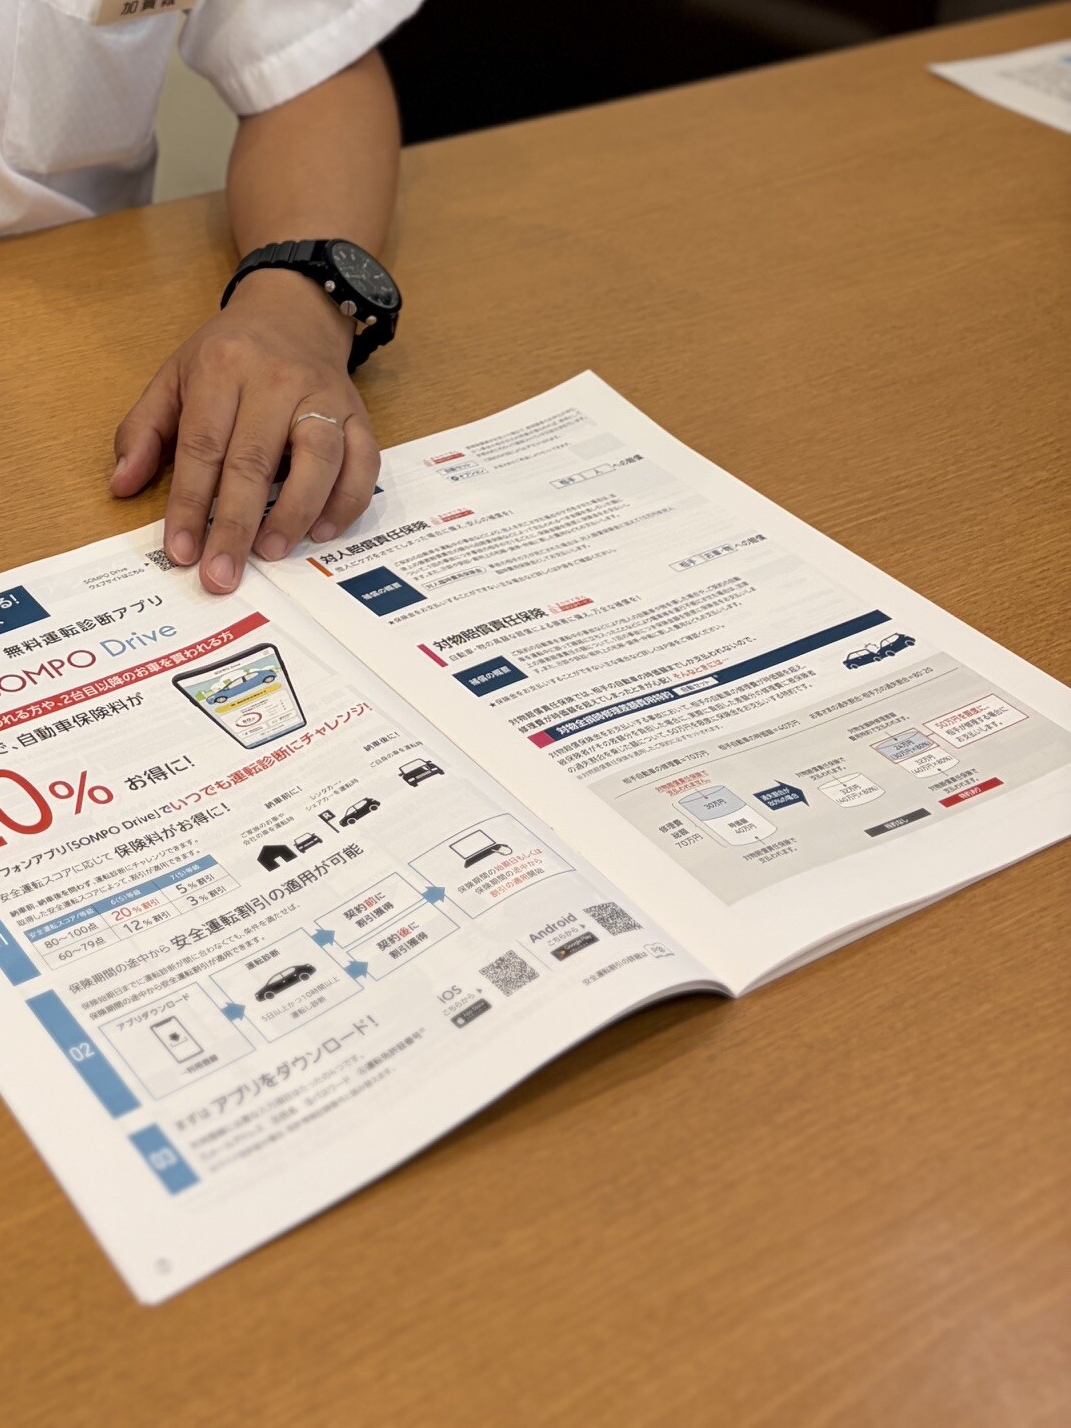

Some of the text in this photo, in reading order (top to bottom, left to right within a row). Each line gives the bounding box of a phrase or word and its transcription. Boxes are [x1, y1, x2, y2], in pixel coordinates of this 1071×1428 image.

[317, 519, 431, 565] 対人賠償責任保険
[110, 566, 128, 575] Drive
[1, 594, 166, 659] 無料運転診断アプリ
[99, 619, 180, 657] Drive
[430, 606, 550, 652] 対物賠償責任保険
[467, 664, 513, 686] 補償の概要
[944, 705, 1010, 736] 相手が修理する場合に
[954, 718, 1005, 743] お支払いします。
[122, 754, 197, 792] お得に!
[913, 753, 937, 765] 32万円
[702, 798, 727, 810] 30万円
[839, 783, 862, 795] 32万円
[111, 801, 232, 859] 保険料がお得に!
[241, 815, 296, 846] 会社の車を運転時
[657, 819, 684, 833] 修理費
[669, 827, 690, 839] 総額
[727, 817, 749, 829] 時価額
[733, 822, 758, 835] 40万円
[673, 833, 705, 849] 70万円
[473, 856, 544, 895] 保険期間の途中から
[487, 866, 545, 898] 割引の適用開始
[67, 841, 367, 995] 保険期間の途中から 安全運転割引の適用が可能
[341, 891, 387, 921] 契約前に
[353, 900, 396, 929] 割引獲得
[375, 919, 421, 951] 契約後に
[526, 911, 579, 943] Android
[544, 925, 580, 947] こちらから
[243, 948, 282, 971] 運転診断
[387, 930, 430, 960] 割引獲得
[260, 974, 341, 1022] 5日以上かつ10時間以上
[434, 983, 464, 1004] iOS
[439, 990, 477, 1016] こちらから
[115, 992, 192, 1032] アプリダウンロード
[67, 1040, 96, 1063] 02
[209, 1013, 381, 1115] アプリをダウンロード!
